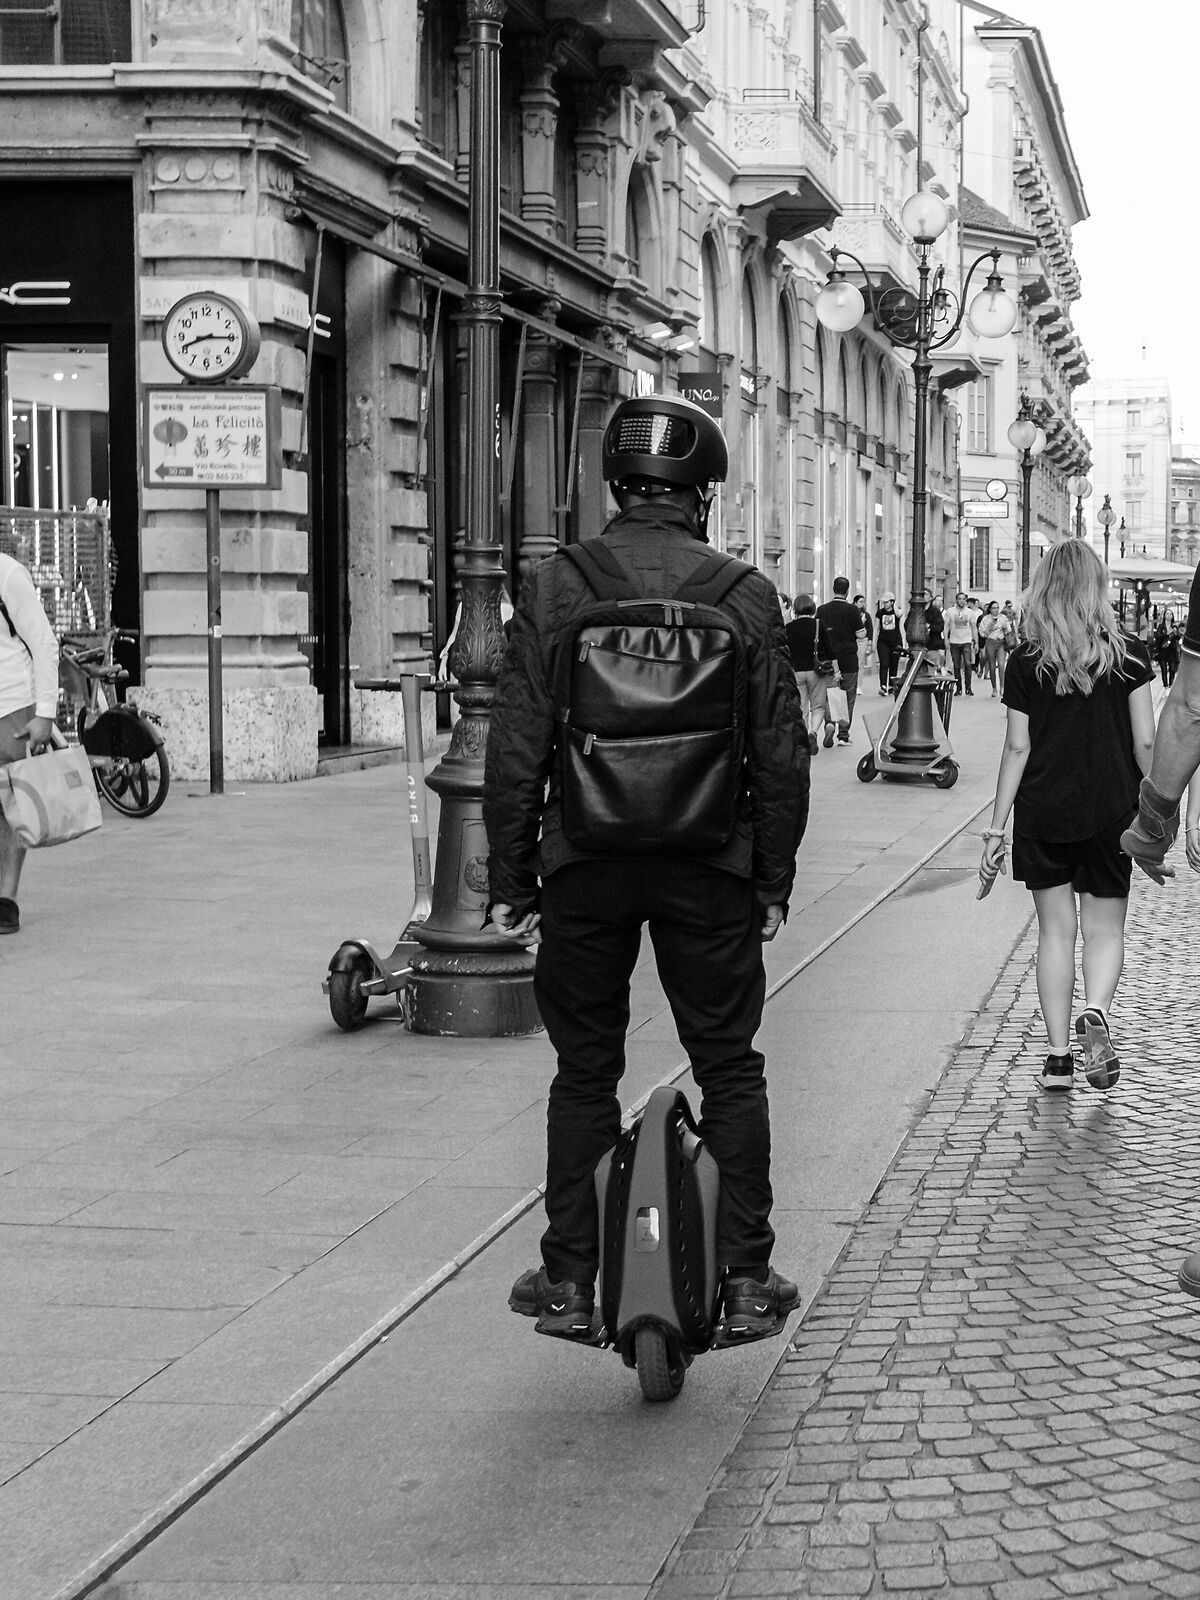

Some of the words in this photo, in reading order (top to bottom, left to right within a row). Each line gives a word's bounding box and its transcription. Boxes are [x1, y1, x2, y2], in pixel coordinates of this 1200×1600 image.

[191, 311, 198, 319] 11
[202, 307, 212, 316] 12
[216, 311, 221, 320] 1
[182, 320, 192, 328] 10
[225, 320, 231, 329] 2
[178, 333, 185, 341] 9
[224, 346, 230, 354] 4
[190, 355, 197, 366] 7
[203, 358, 210, 367] 6
[216, 355, 222, 364] 5
[192, 415, 209, 428] La
